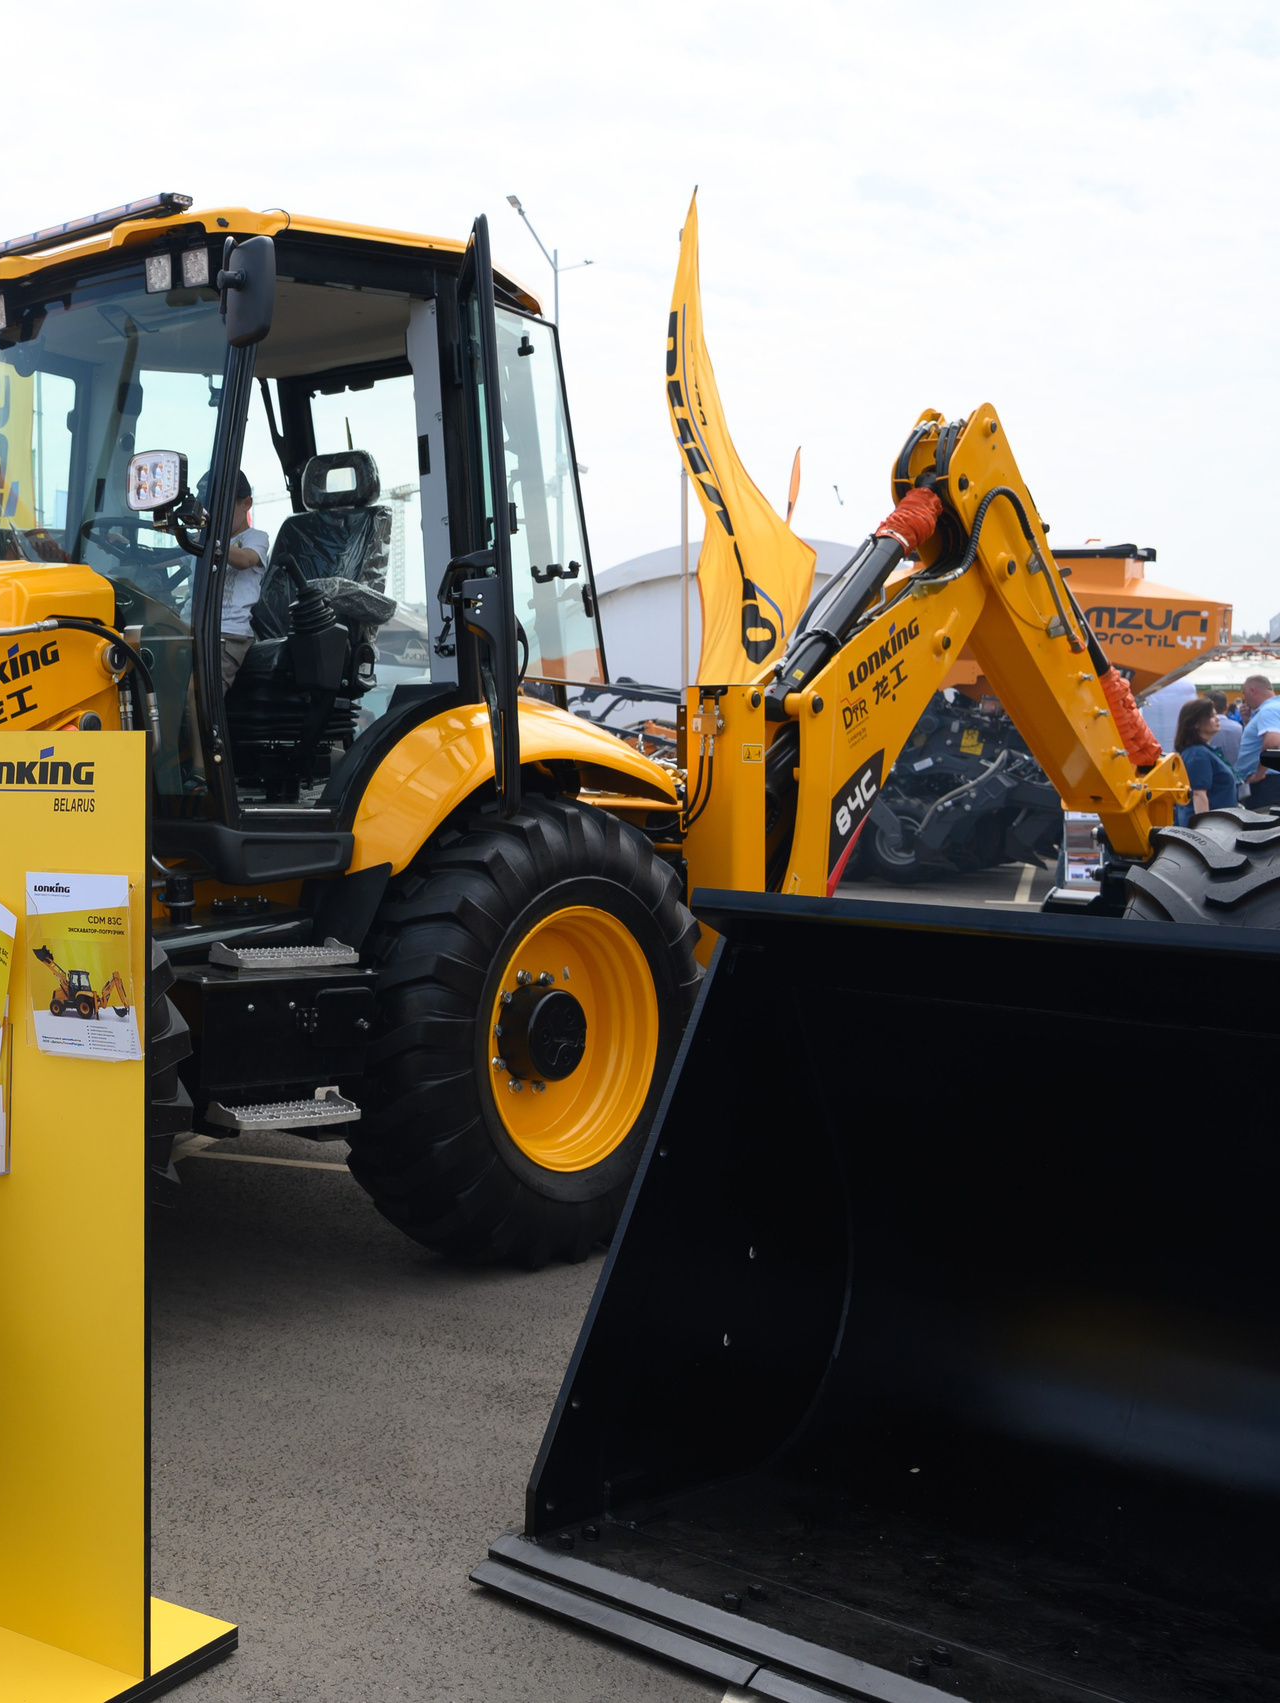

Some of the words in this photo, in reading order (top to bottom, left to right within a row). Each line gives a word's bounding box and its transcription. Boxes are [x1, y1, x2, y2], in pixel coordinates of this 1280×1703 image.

[1176, 635, 1208, 650] 4T
[872, 659, 908, 705] 龙工
[53, 797, 96, 813] BELARUS
[835, 767, 877, 836] 84C
[87, 915, 106, 925] CDM
